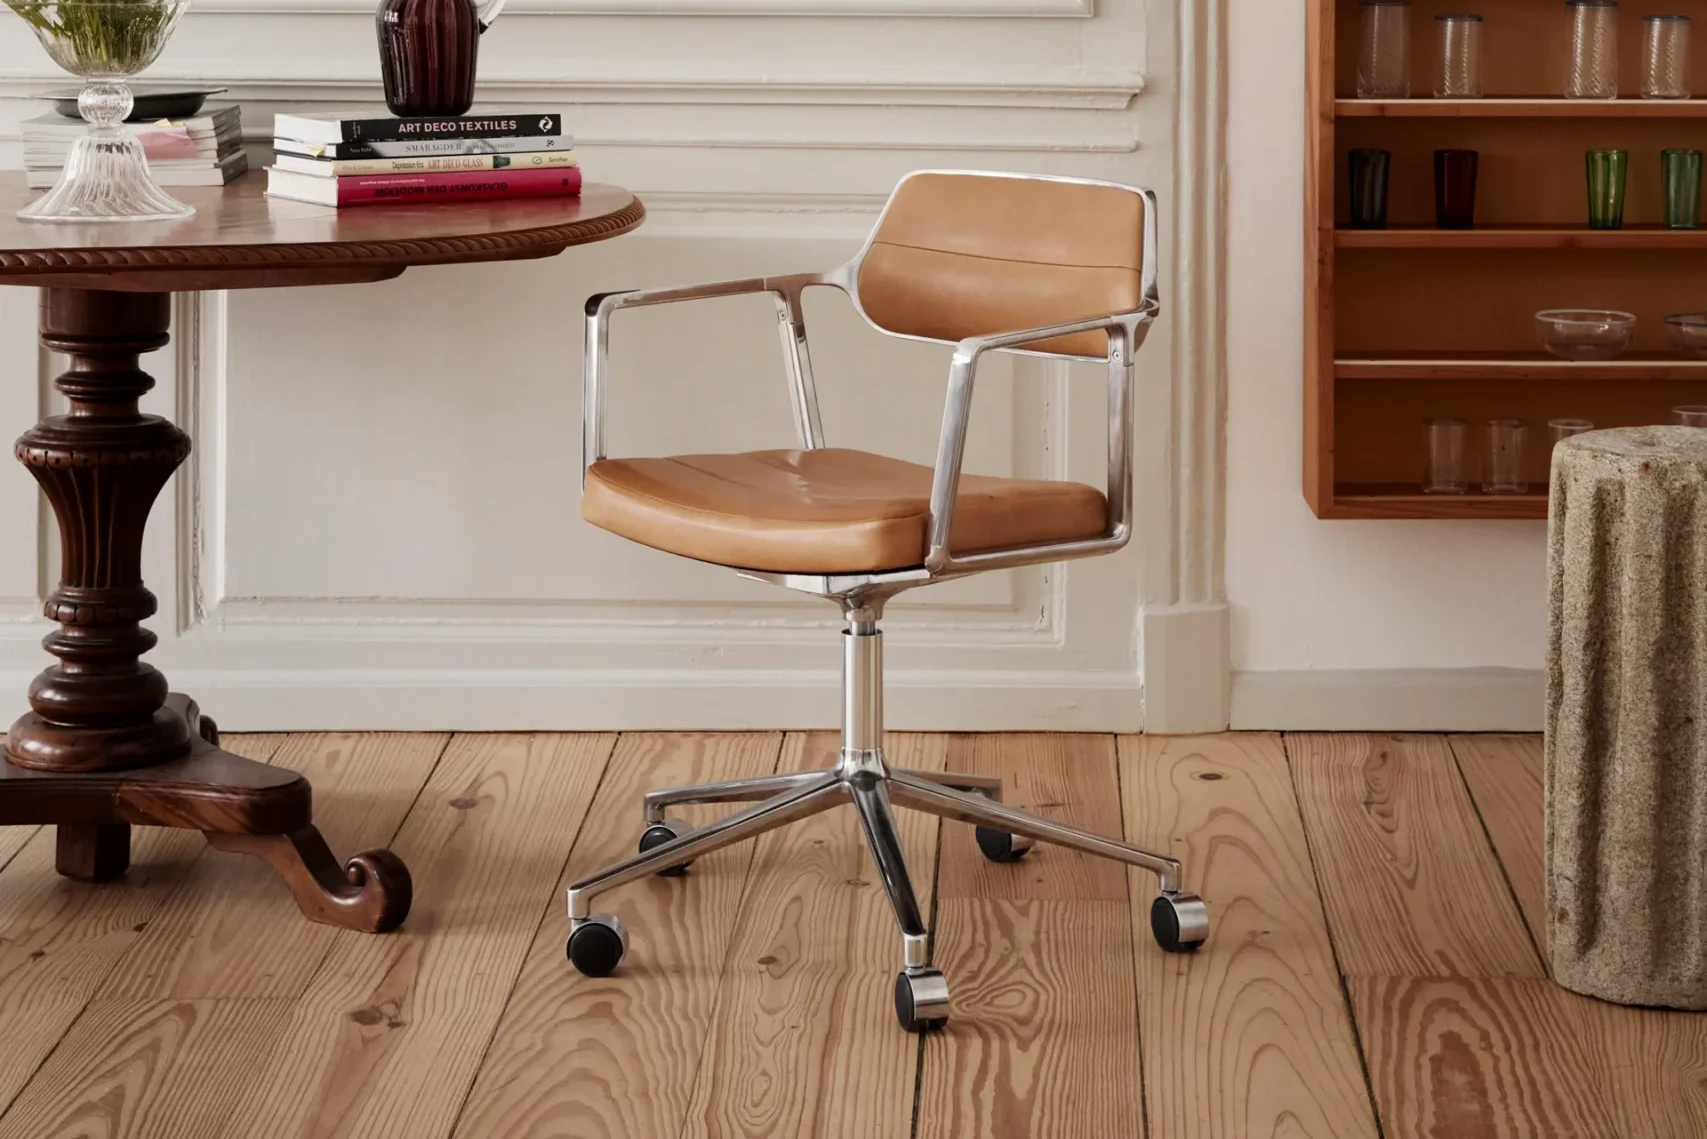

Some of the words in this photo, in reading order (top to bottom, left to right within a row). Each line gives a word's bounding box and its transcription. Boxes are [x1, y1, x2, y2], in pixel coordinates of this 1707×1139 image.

[398, 123, 421, 133] ART
[424, 122, 456, 132] DECO
[459, 120, 517, 131] TEXTILES
[405, 142, 462, 153] SMARAGDER
[392, 161, 416, 170] Depression
[426, 159, 440, 170] ART
[443, 158, 460, 169] DECO
[463, 157, 484, 168] GLASS
[374, 186, 425, 197] MODERNE
[427, 185, 447, 195] DER
[450, 182, 508, 193] GLASKUNST
